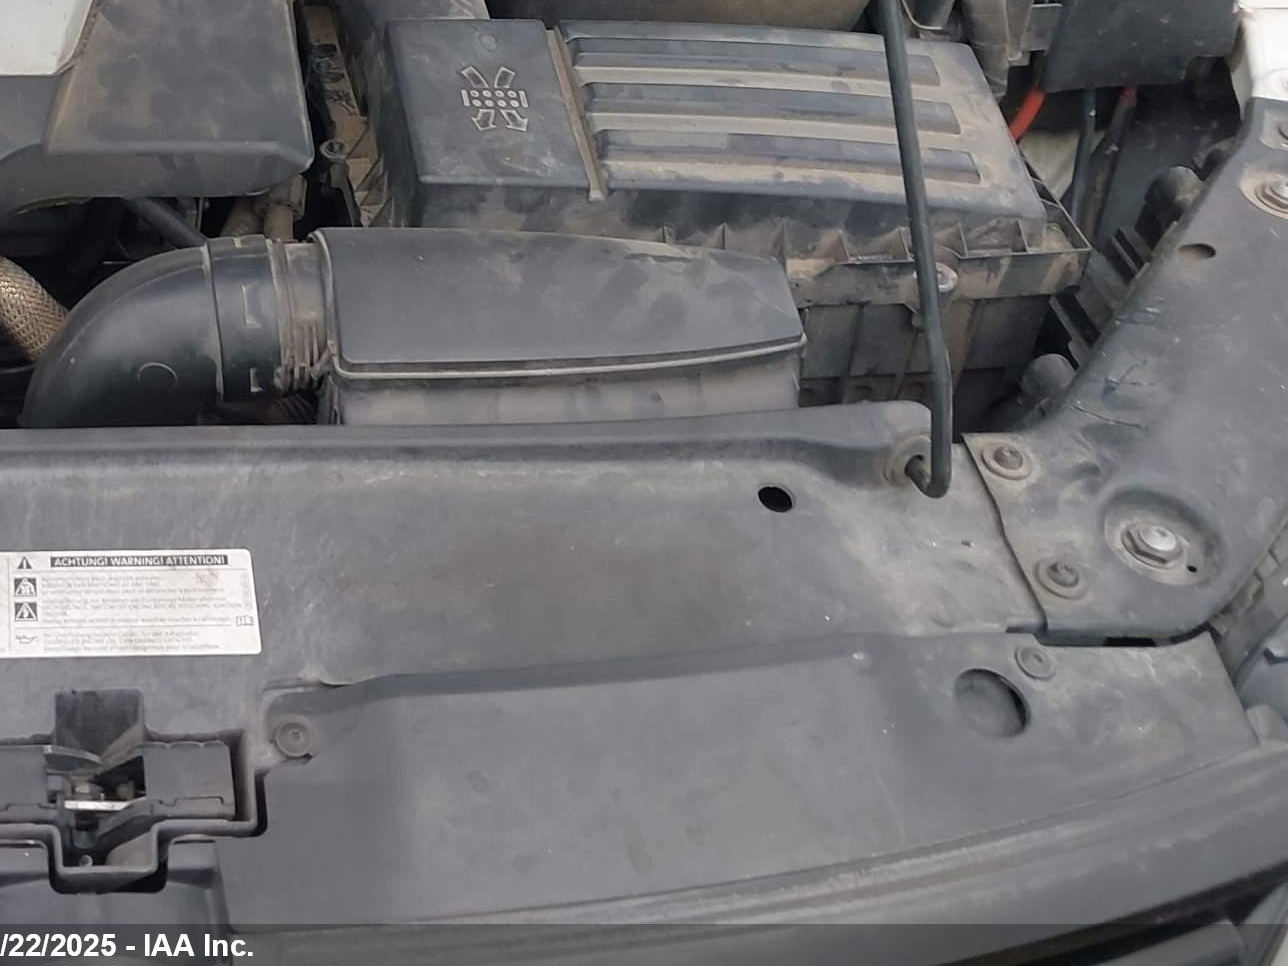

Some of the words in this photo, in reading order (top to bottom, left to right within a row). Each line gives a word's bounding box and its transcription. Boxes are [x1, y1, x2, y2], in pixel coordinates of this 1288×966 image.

[53, 556, 109, 567] ACHTUNG!
[111, 555, 163, 566] WARNING!
[165, 554, 225, 566] ATTENTION!
